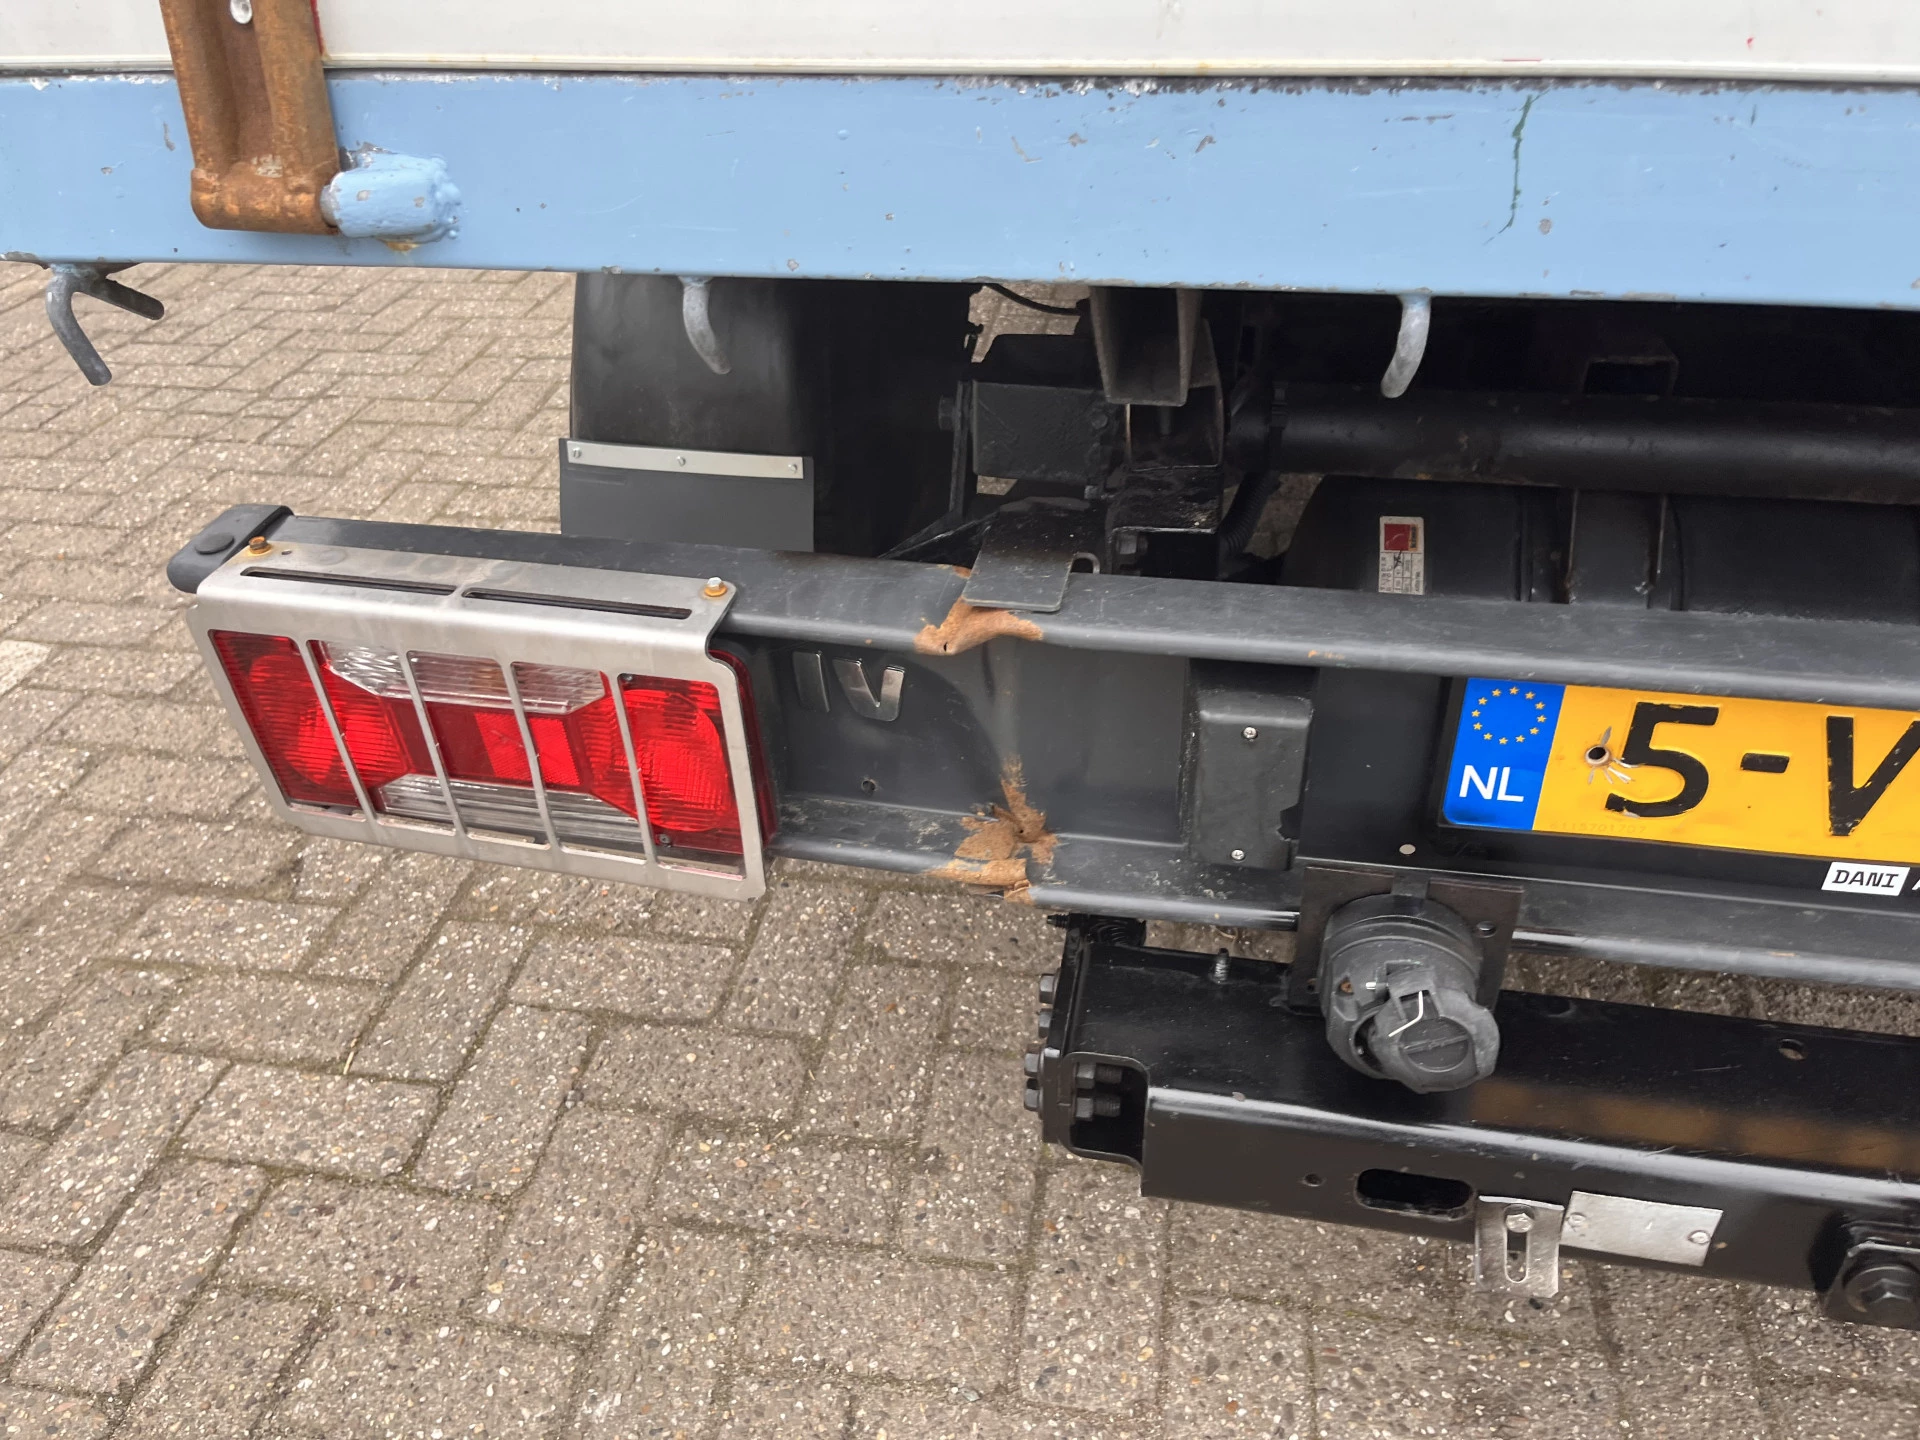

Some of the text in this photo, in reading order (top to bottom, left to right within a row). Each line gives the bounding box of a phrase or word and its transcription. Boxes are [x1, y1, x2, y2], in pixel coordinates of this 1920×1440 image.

[1458, 764, 1525, 803] NL
[1604, 701, 1920, 837] 5-V
[1832, 869, 1900, 889] DANI
